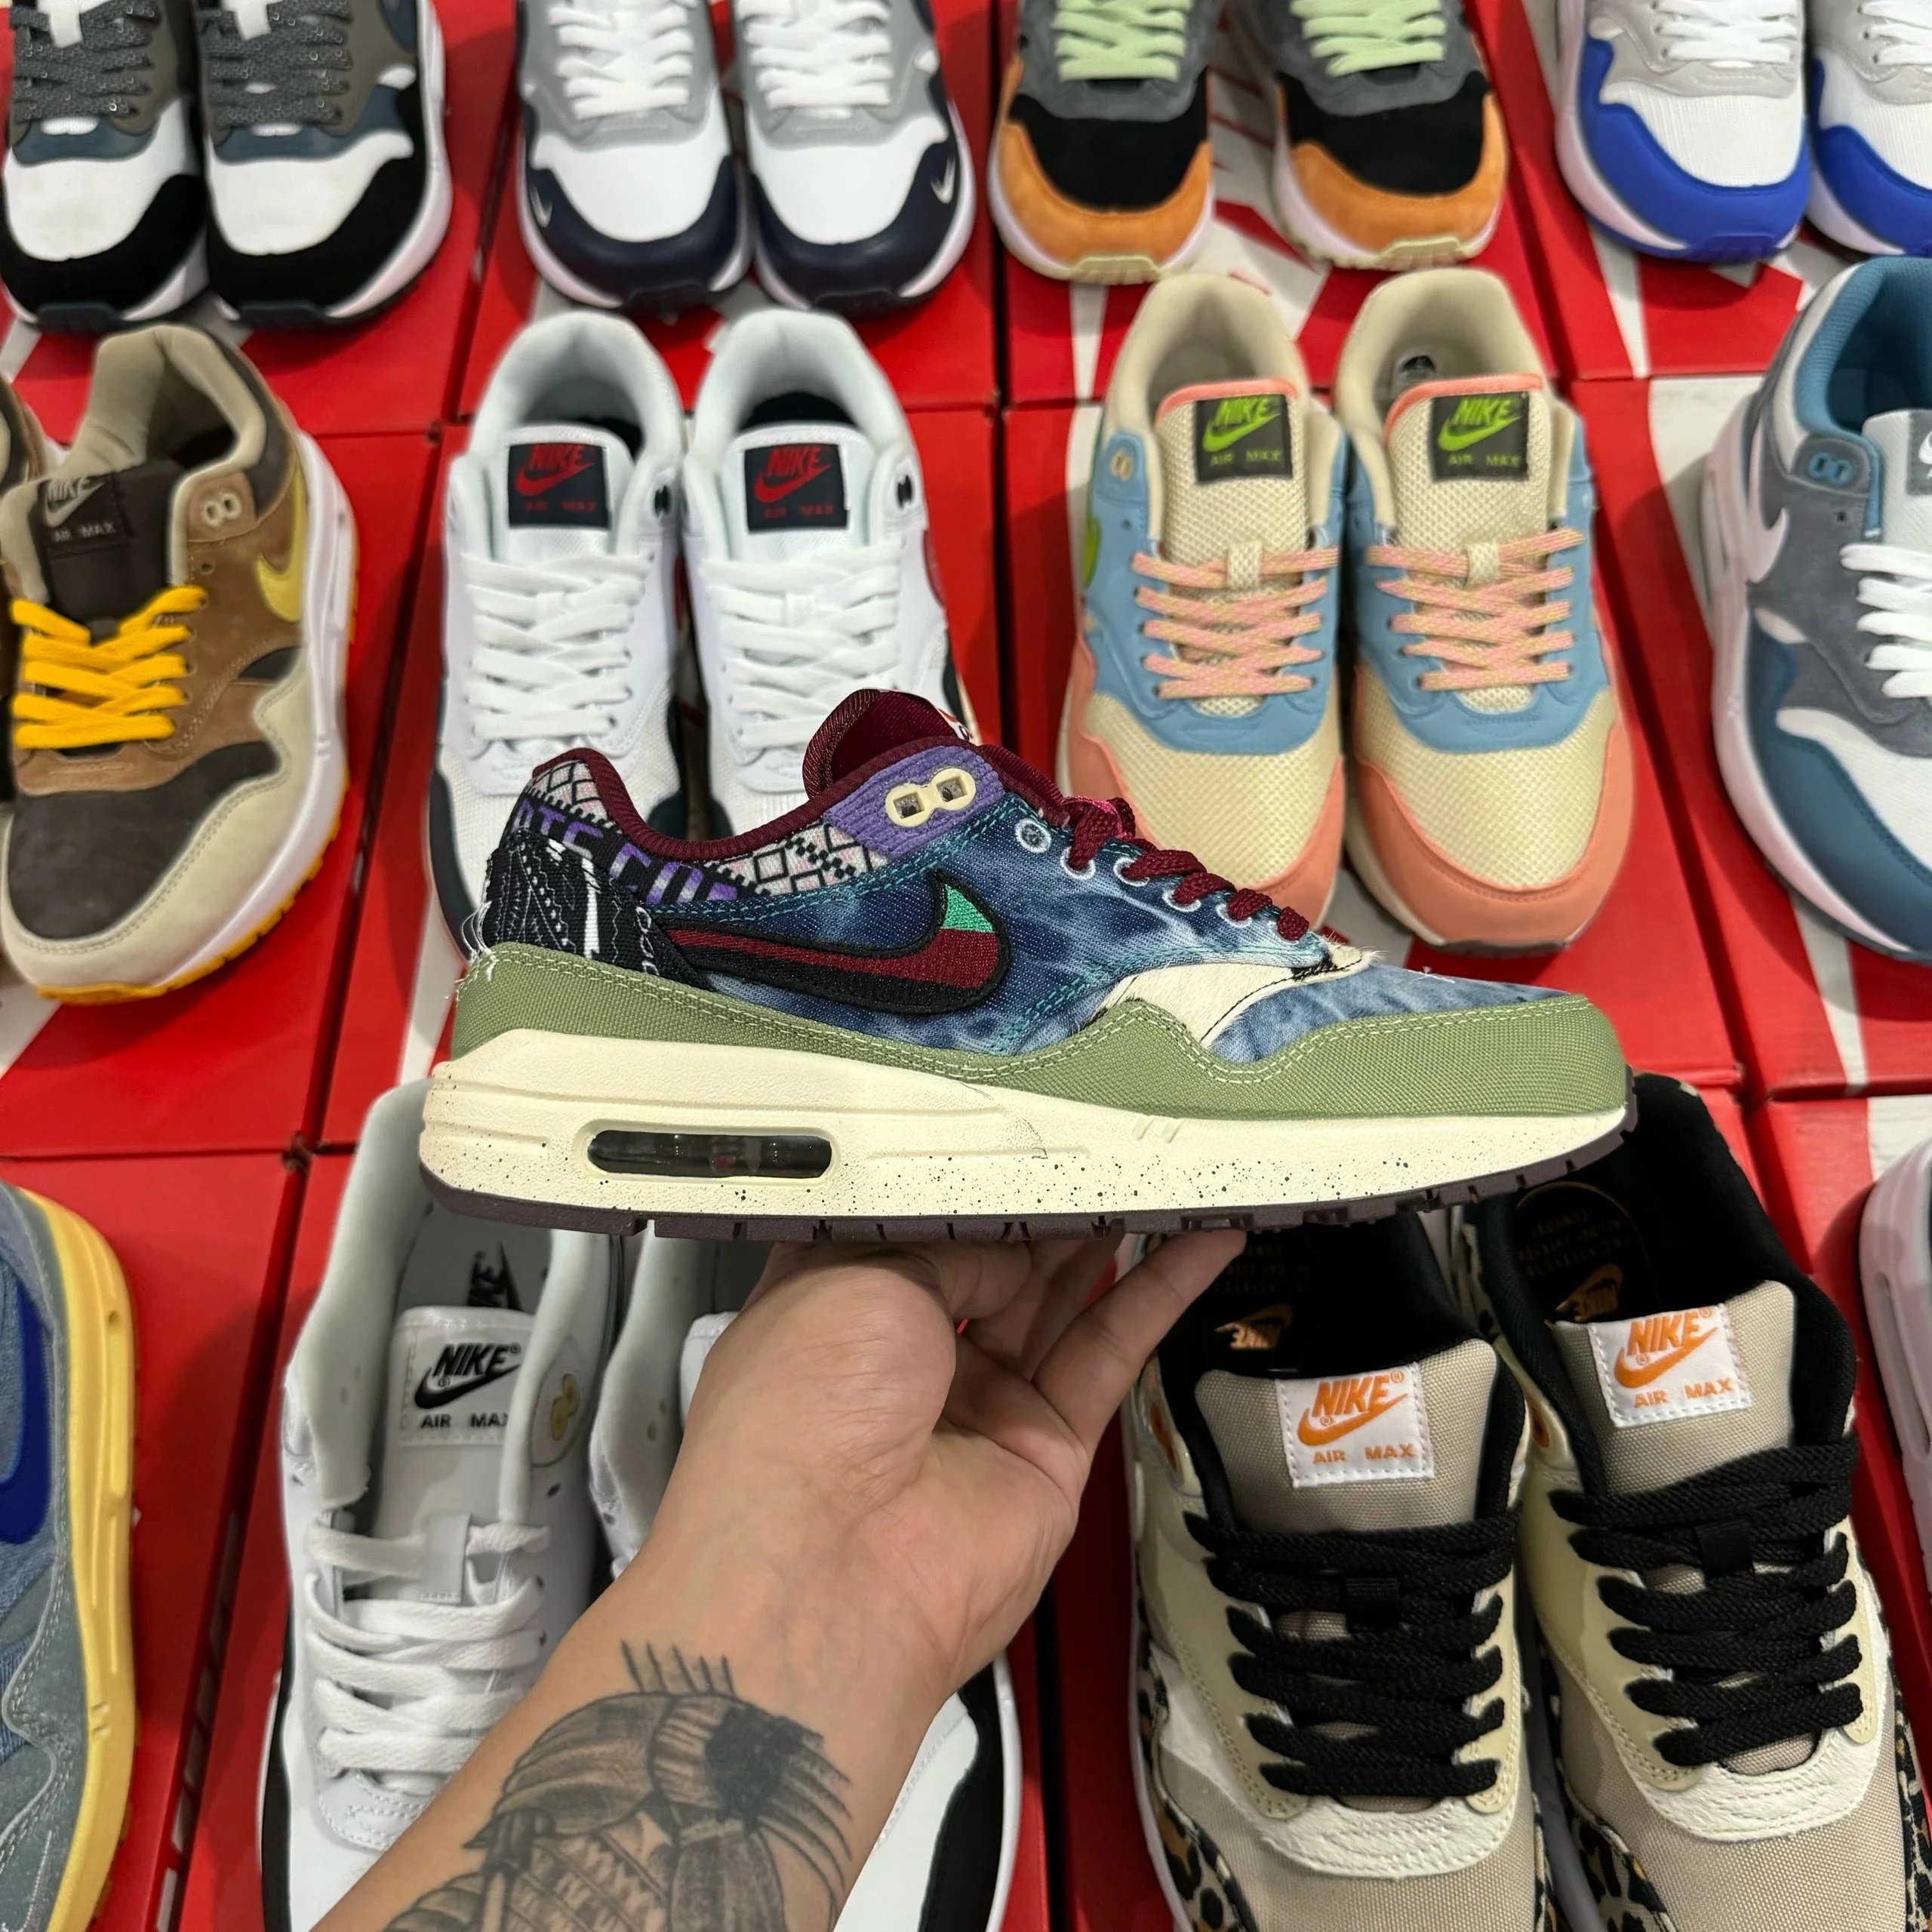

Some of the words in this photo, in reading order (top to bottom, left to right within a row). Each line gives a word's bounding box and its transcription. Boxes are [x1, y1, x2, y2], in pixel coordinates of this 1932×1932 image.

[1216, 397, 1270, 426] NIKE
[1453, 398, 1511, 425] NIKE
[530, 443, 586, 470] NIKE
[765, 445, 821, 477] NIKE
[47, 475, 91, 502] NIKE
[1626, 1310, 1701, 1357] NIKE
[432, 1343, 510, 1377] NIKE
[1311, 1374, 1390, 1418] NIKE
[1635, 1389, 1668, 1408] AIR
[1684, 1377, 1734, 1399] MAX
[420, 1414, 452, 1429] AIR
[1312, 1449, 1346, 1465] AIR
[1364, 1443, 1415, 1460] MAX
